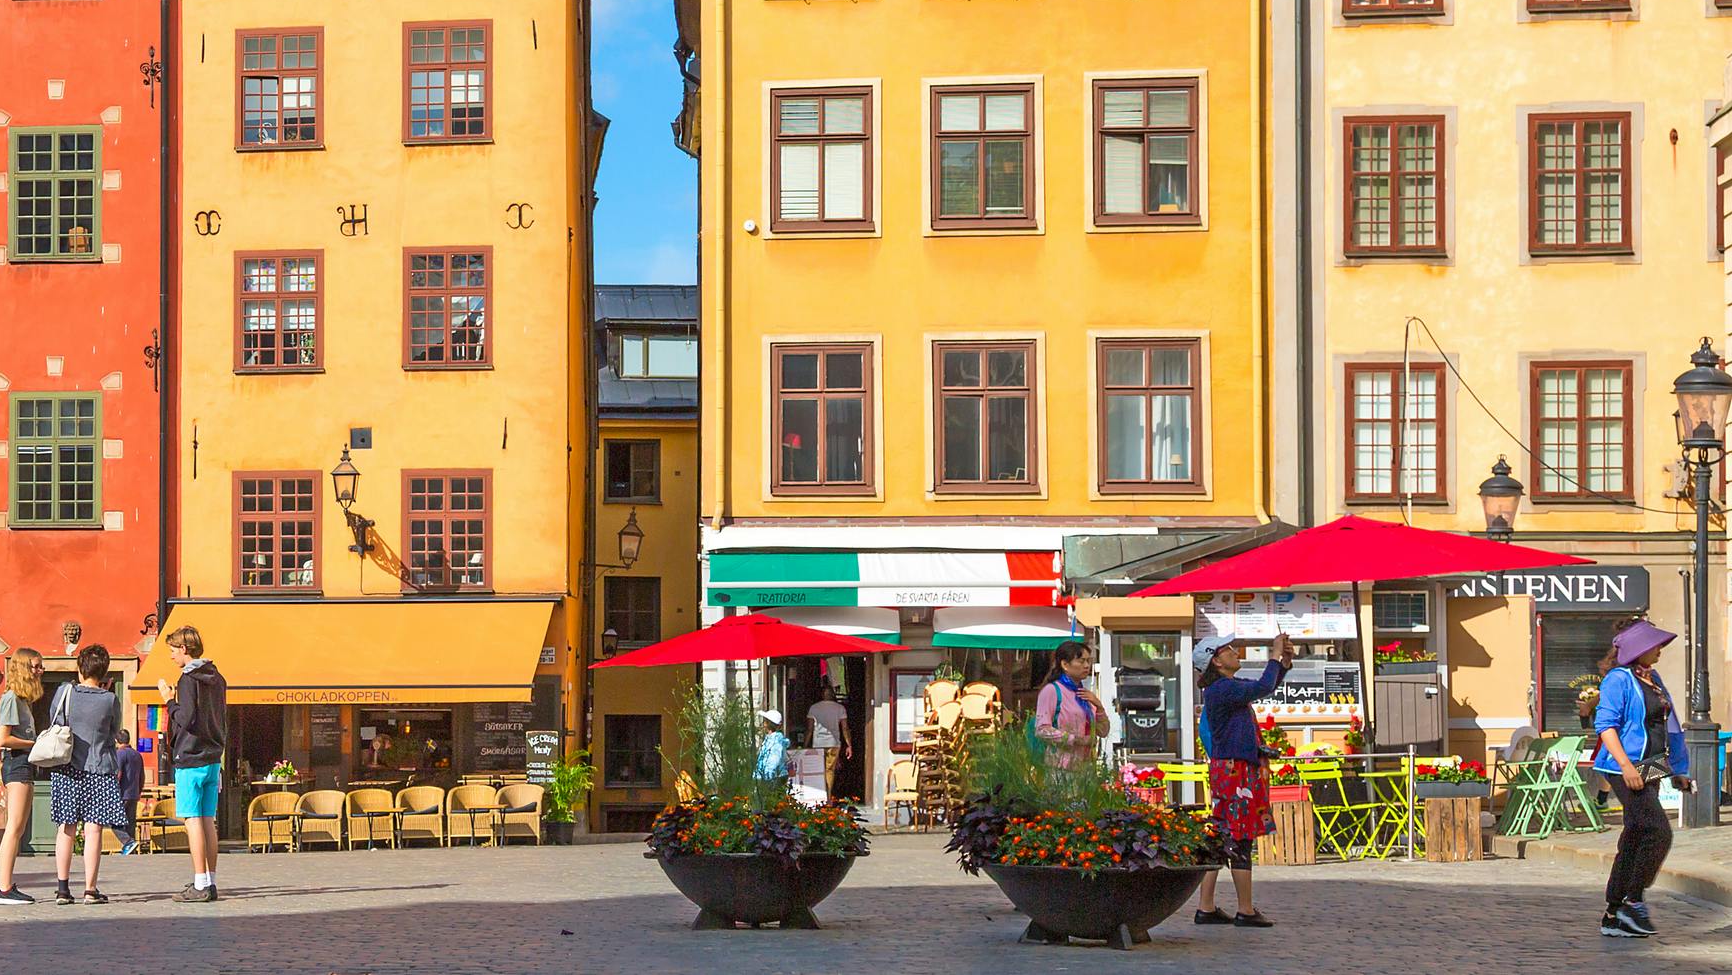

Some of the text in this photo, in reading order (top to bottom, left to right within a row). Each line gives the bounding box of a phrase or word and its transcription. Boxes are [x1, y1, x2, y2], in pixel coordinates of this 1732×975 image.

[756, 592, 806, 603] TRATTORIA
[896, 589, 970, 603] DE SVARTA FÅREN
